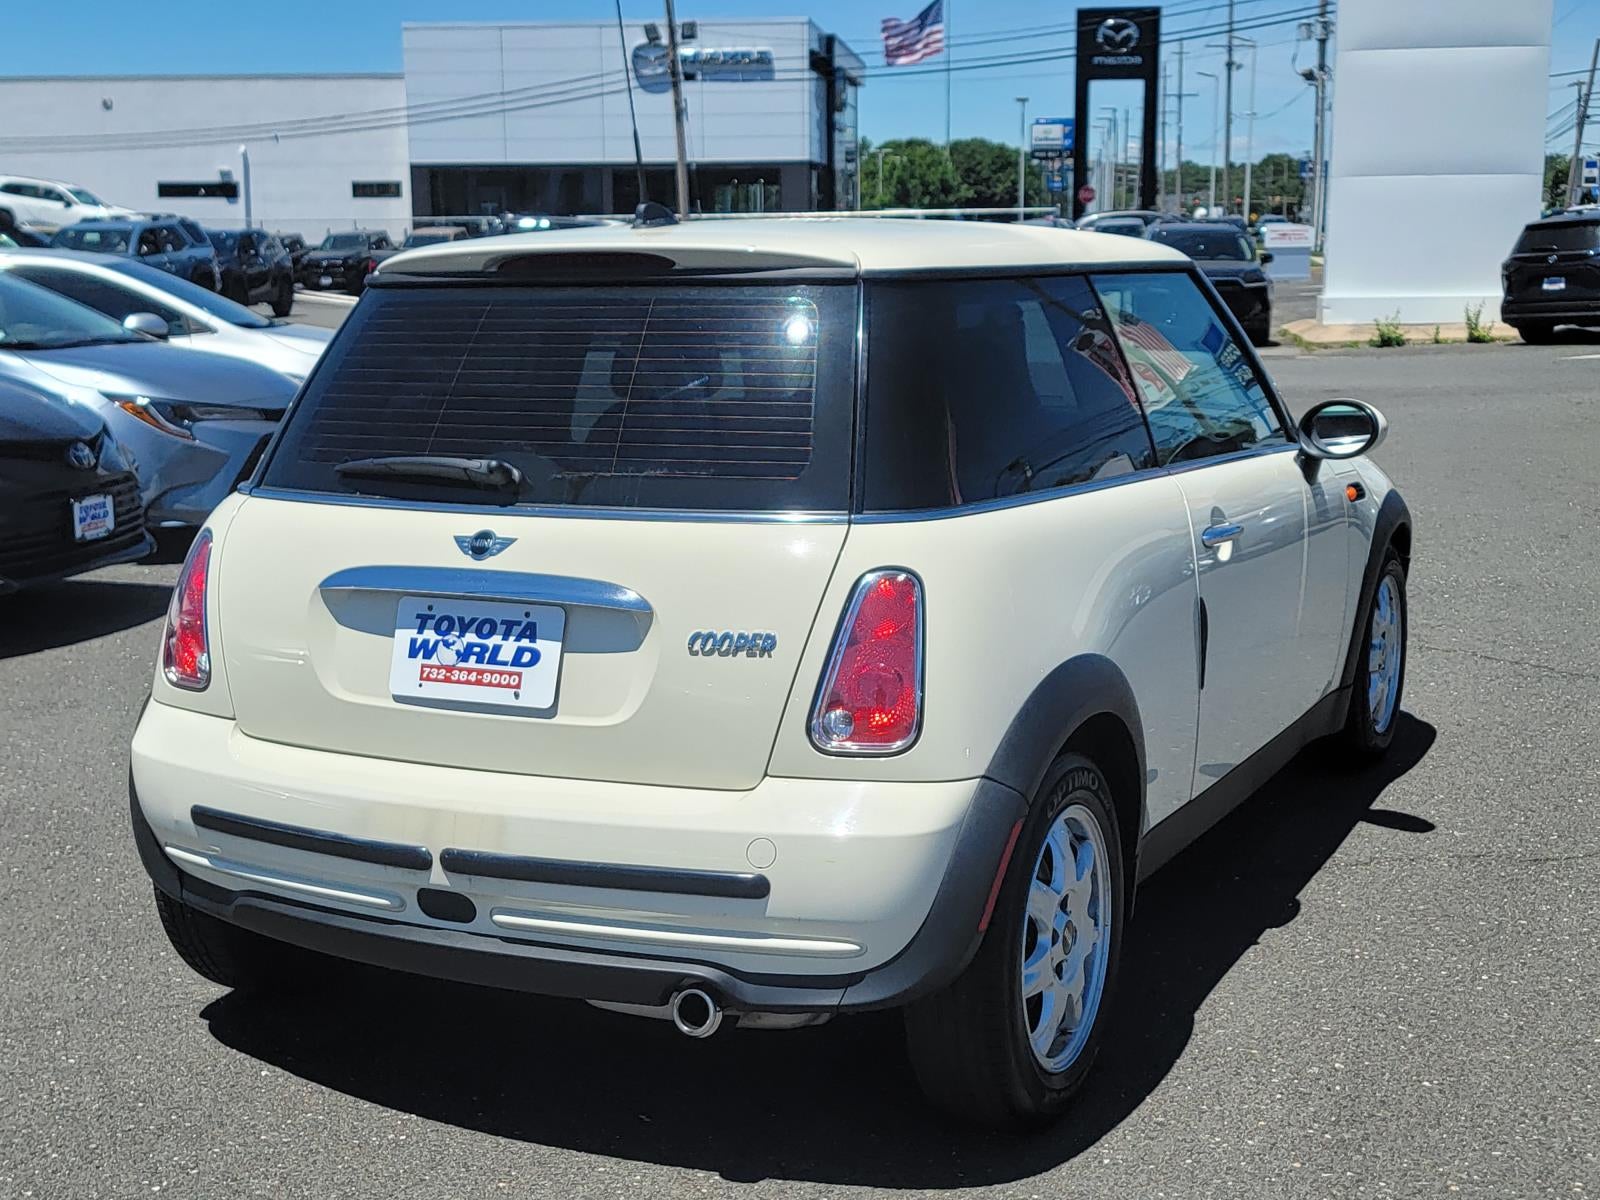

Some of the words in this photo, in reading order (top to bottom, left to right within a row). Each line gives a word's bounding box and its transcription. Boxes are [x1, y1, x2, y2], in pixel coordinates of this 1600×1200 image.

[415, 613, 537, 643] TOYOTA
[687, 631, 777, 658] COOPER
[422, 667, 519, 685] 732-364-9000
